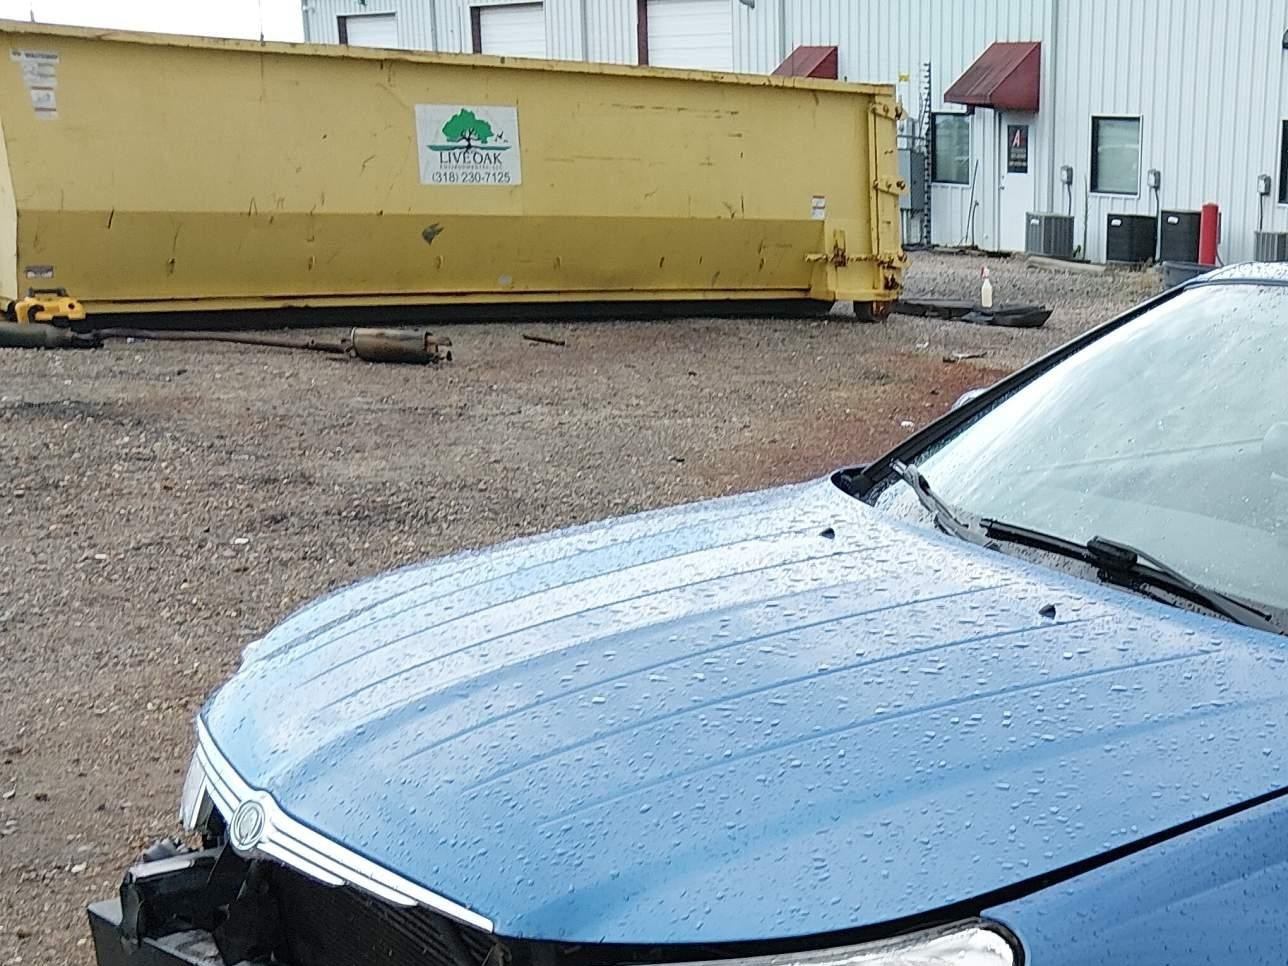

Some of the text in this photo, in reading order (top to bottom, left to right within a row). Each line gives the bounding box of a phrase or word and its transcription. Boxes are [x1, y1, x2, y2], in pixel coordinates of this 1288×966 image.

[440, 151, 503, 165] LIVE OAK
[432, 171, 511, 183] (318) 230-7125
